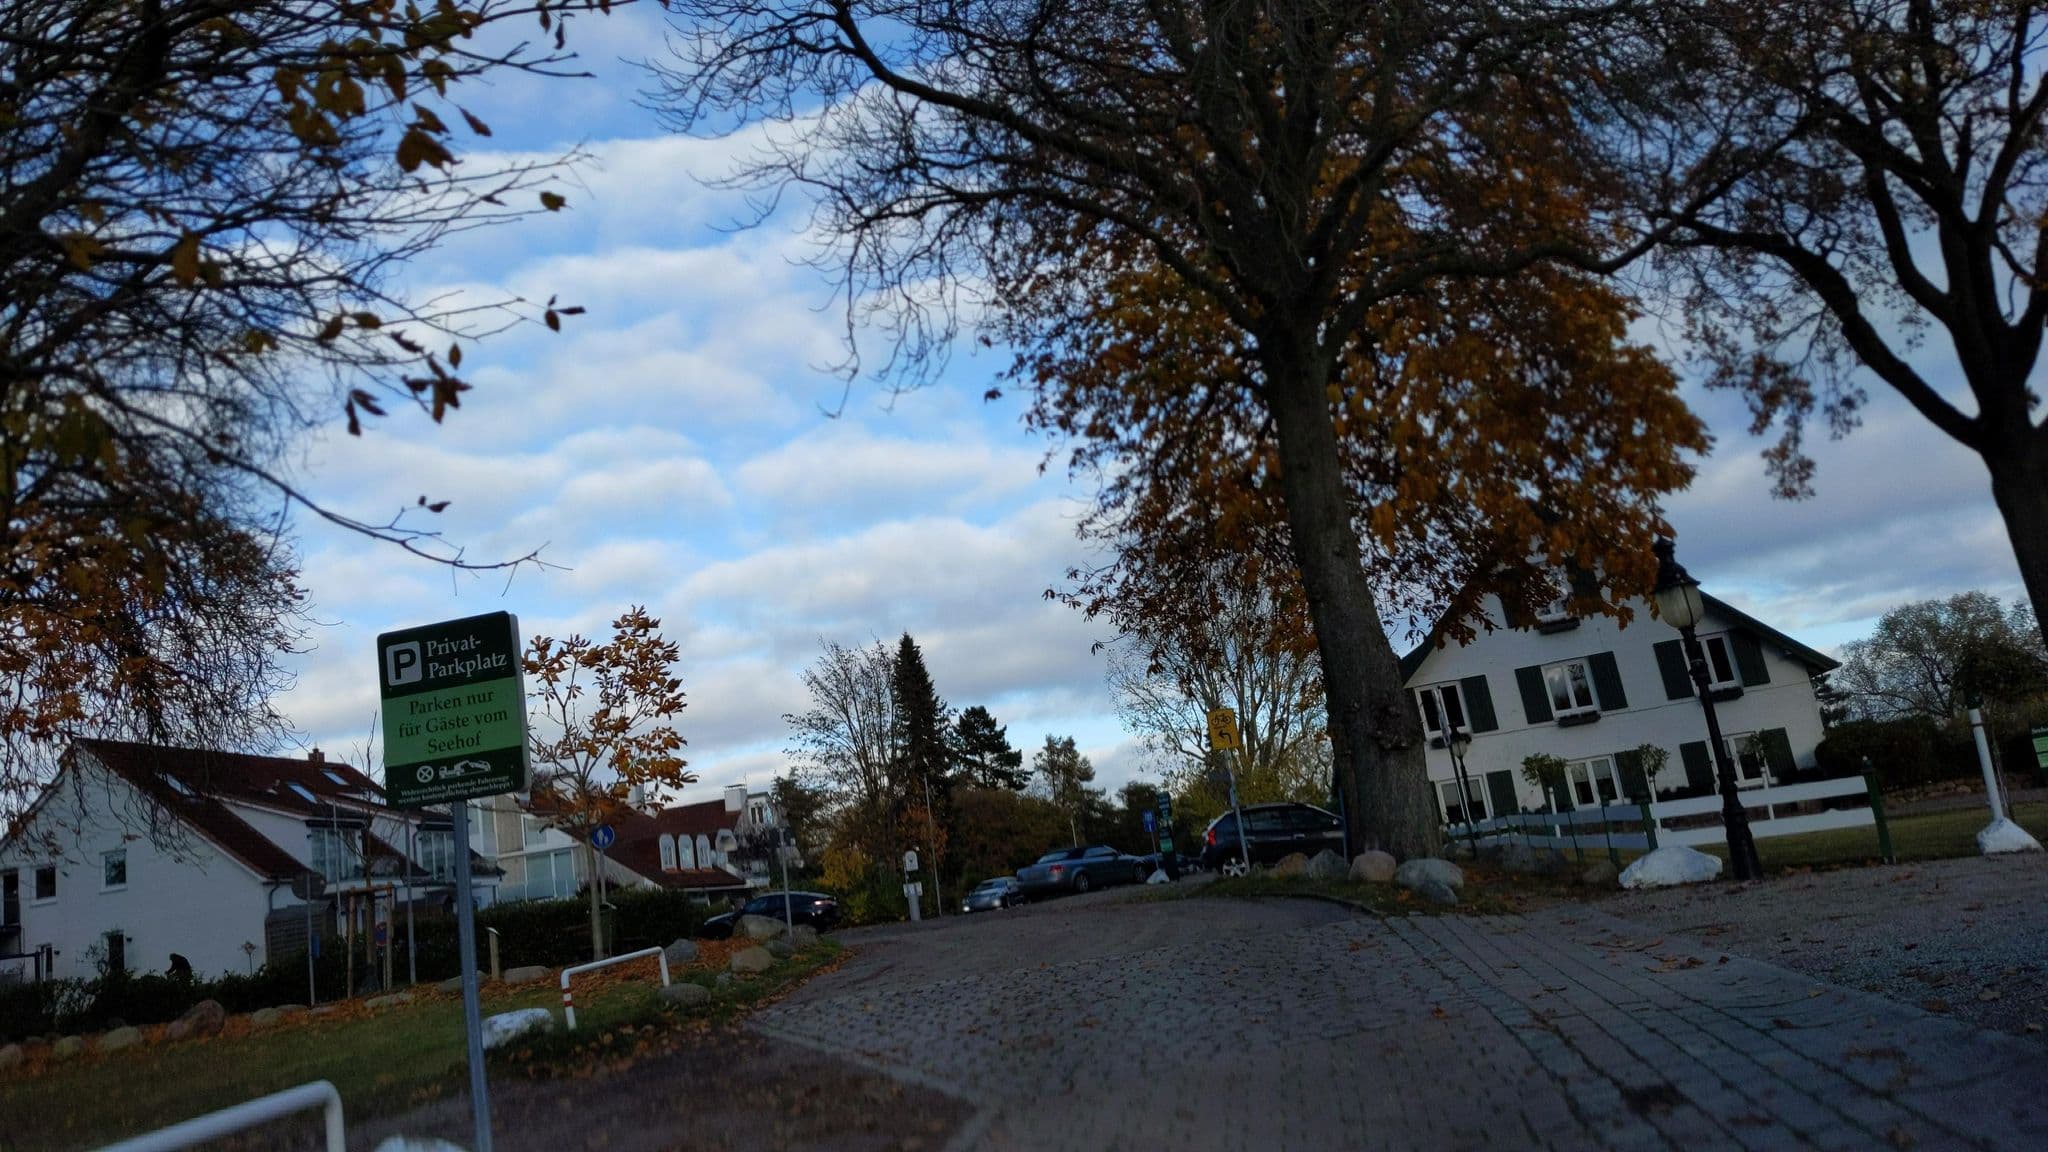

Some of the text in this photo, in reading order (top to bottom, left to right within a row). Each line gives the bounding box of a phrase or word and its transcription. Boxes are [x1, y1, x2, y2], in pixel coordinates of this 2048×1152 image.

[426, 634, 482, 657] Privat-
[393, 648, 417, 680] P
[428, 653, 508, 678] Parkplatz
[409, 691, 495, 716] Parken nur
[399, 710, 508, 738] für Gäste vom
[428, 731, 482, 754] Seehof
